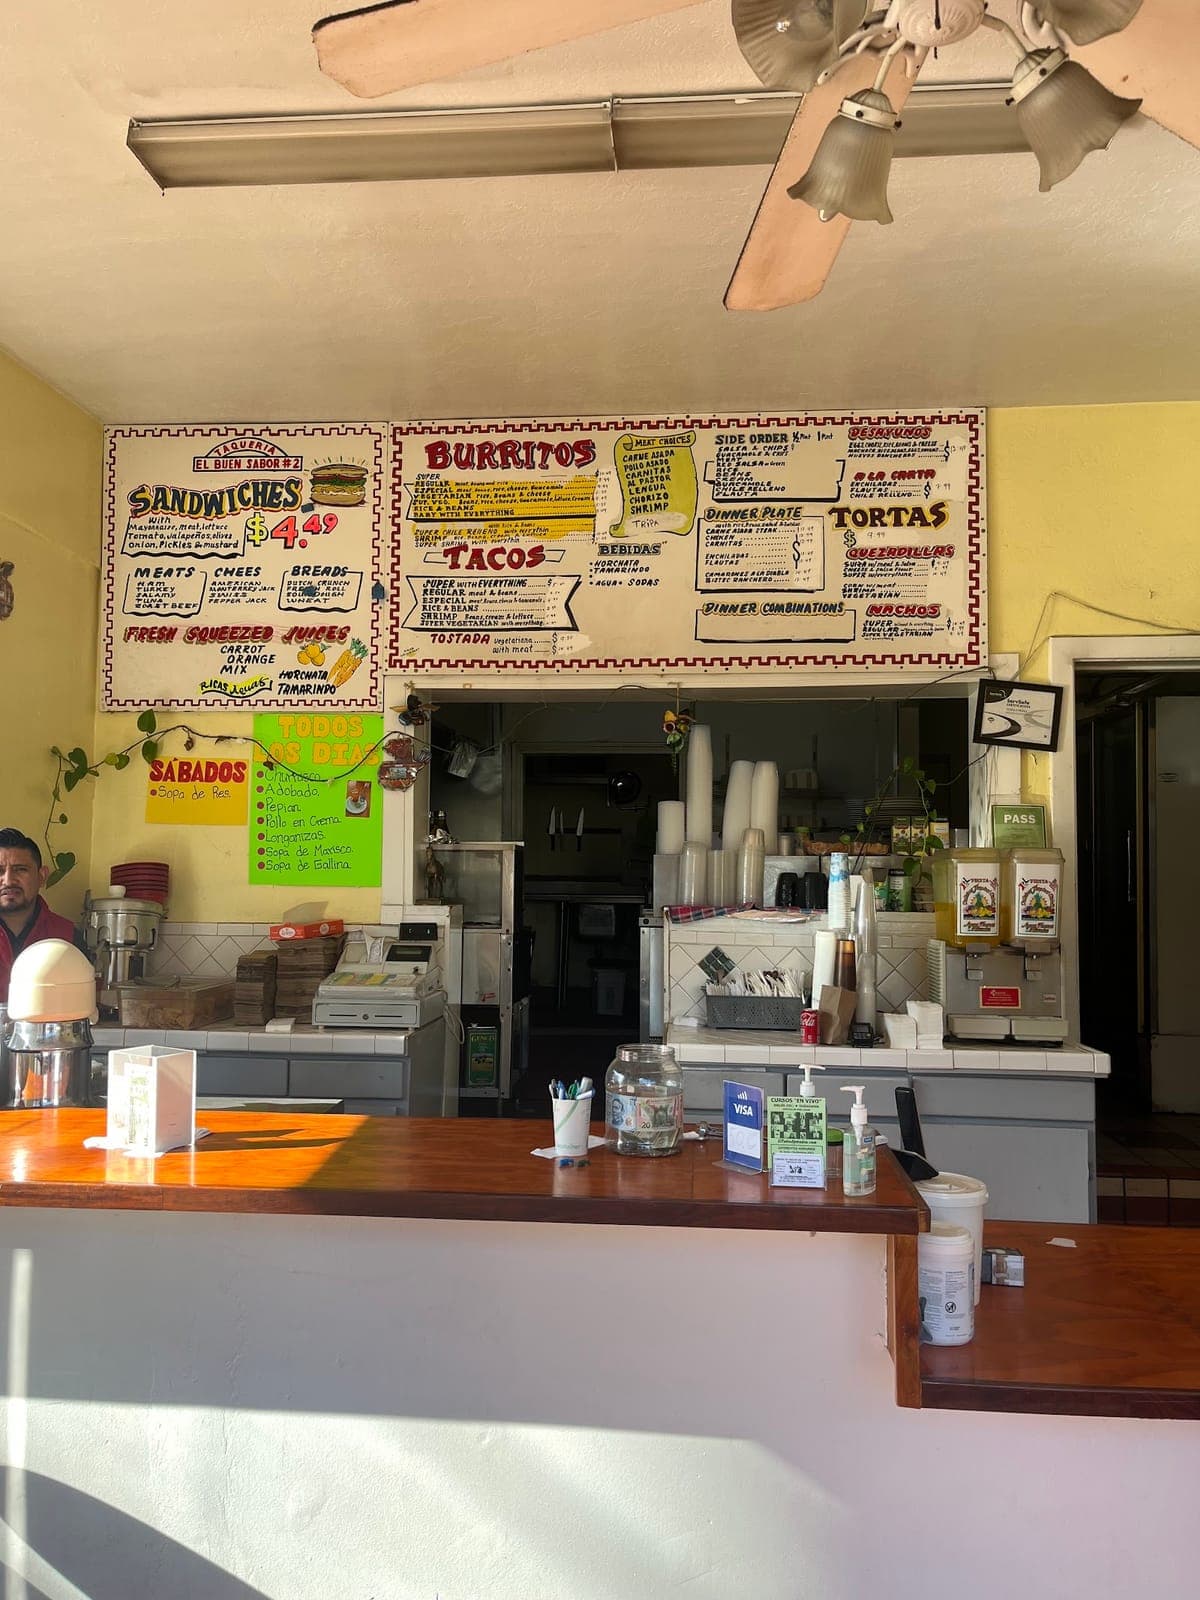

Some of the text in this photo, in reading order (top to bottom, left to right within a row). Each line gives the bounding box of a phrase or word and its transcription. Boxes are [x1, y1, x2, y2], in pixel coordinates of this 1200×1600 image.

[715, 432, 789, 446] SIDE ORDER
[848, 425, 933, 440] DESAYUNOS
[634, 435, 692, 448] MEAT CHOICES
[214, 441, 276, 457] TAQUERIA
[424, 439, 596, 471] BURRITOS
[622, 449, 675, 463] CARNE ASADA
[196, 459, 209, 470] EL
[214, 459, 242, 469] BUEN
[246, 458, 280, 469] SABOR
[624, 459, 669, 473] POLLO ASADO
[735, 460, 765, 468] SALSA
[625, 466, 672, 480] CARNITAS
[627, 475, 672, 488] AL PASTOR
[628, 485, 667, 496] LENGUA
[128, 477, 303, 519] SANDWICHES
[629, 493, 670, 505] CHORIZO
[464, 509, 515, 518] EVERYTHING
[630, 503, 670, 515] SHRIMP
[704, 506, 803, 521] DINNER PLATE
[828, 501, 949, 529] TORTAS
[599, 543, 662, 557] BEBIDAS
[705, 540, 744, 548] CARNITAS
[442, 544, 546, 571] TACOS
[846, 543, 956, 560] QUEZADILLAS
[593, 566, 650, 574] TAMARINDO
[594, 560, 640, 568] HORCHATA
[134, 566, 196, 578] MEATS
[214, 566, 262, 578] CHEES
[291, 565, 349, 577] BREADS
[422, 579, 456, 589] SUPER
[478, 578, 528, 589] EVERYTHING
[595, 578, 660, 588] AGUA SODAS
[422, 588, 467, 597] REGULAR
[421, 604, 479, 612] RICE BEANS
[702, 601, 847, 616] DINNER COMBINATIONS
[865, 603, 943, 619] NACHOS
[420, 611, 458, 621] SHRIMP
[862, 619, 893, 628] SUPER
[124, 625, 352, 645] FRESH SQUEEZED JUICES
[430, 632, 491, 645] TOSTADA
[220, 645, 265, 654] CARROT
[492, 643, 534, 654] with meat
[227, 654, 278, 664] ORANGE
[220, 665, 248, 675] MIX
[278, 670, 329, 680] HORCHATA
[277, 683, 337, 696] TAMARINDO
[278, 714, 364, 739] TODOS
[149, 757, 247, 783] SÁBADOS
[158, 785, 185, 804] Sopa
[191, 784, 206, 800] de
[293, 819, 306, 828] en
[1003, 814, 1036, 825] PASS
[265, 846, 290, 860] Sopa
[295, 845, 310, 857] de
[265, 859, 292, 874] Sopa
[297, 858, 311, 872] de
[733, 1103, 753, 1118] VISA
